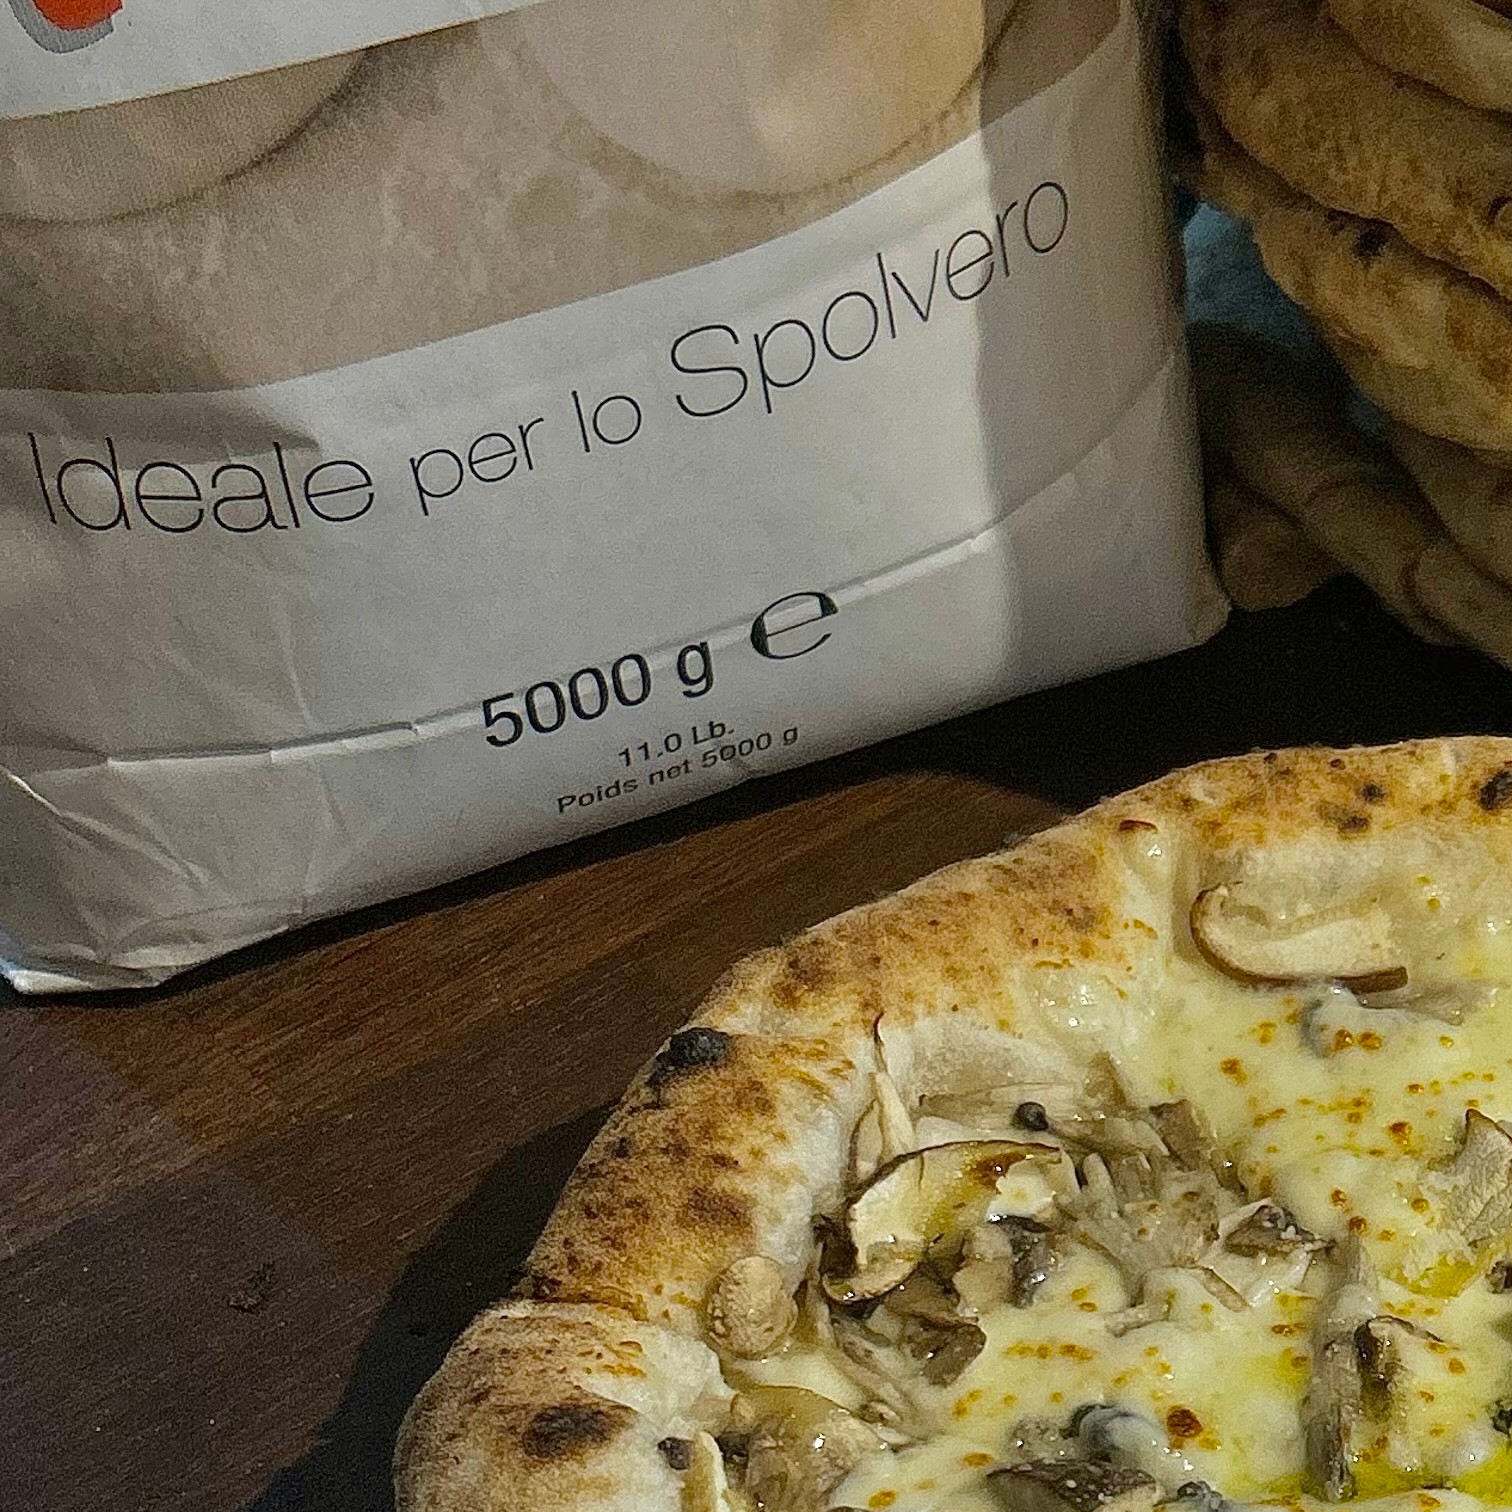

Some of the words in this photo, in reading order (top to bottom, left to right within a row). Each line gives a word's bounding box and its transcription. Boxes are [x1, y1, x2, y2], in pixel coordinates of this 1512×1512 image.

[27, 431, 375, 533] Ideale
[409, 416, 544, 517] per
[571, 390, 642, 454] lo
[670, 181, 1069, 418] Spolvero
[481, 653, 652, 748] 5000
[677, 641, 714, 699] g
[556, 777, 638, 814] Poids
[649, 760, 692, 786] net
[702, 733, 773, 768] 5000
[782, 726, 799, 746] g
[618, 732, 683, 767] 11.0
[692, 720, 735, 746] Lb.
